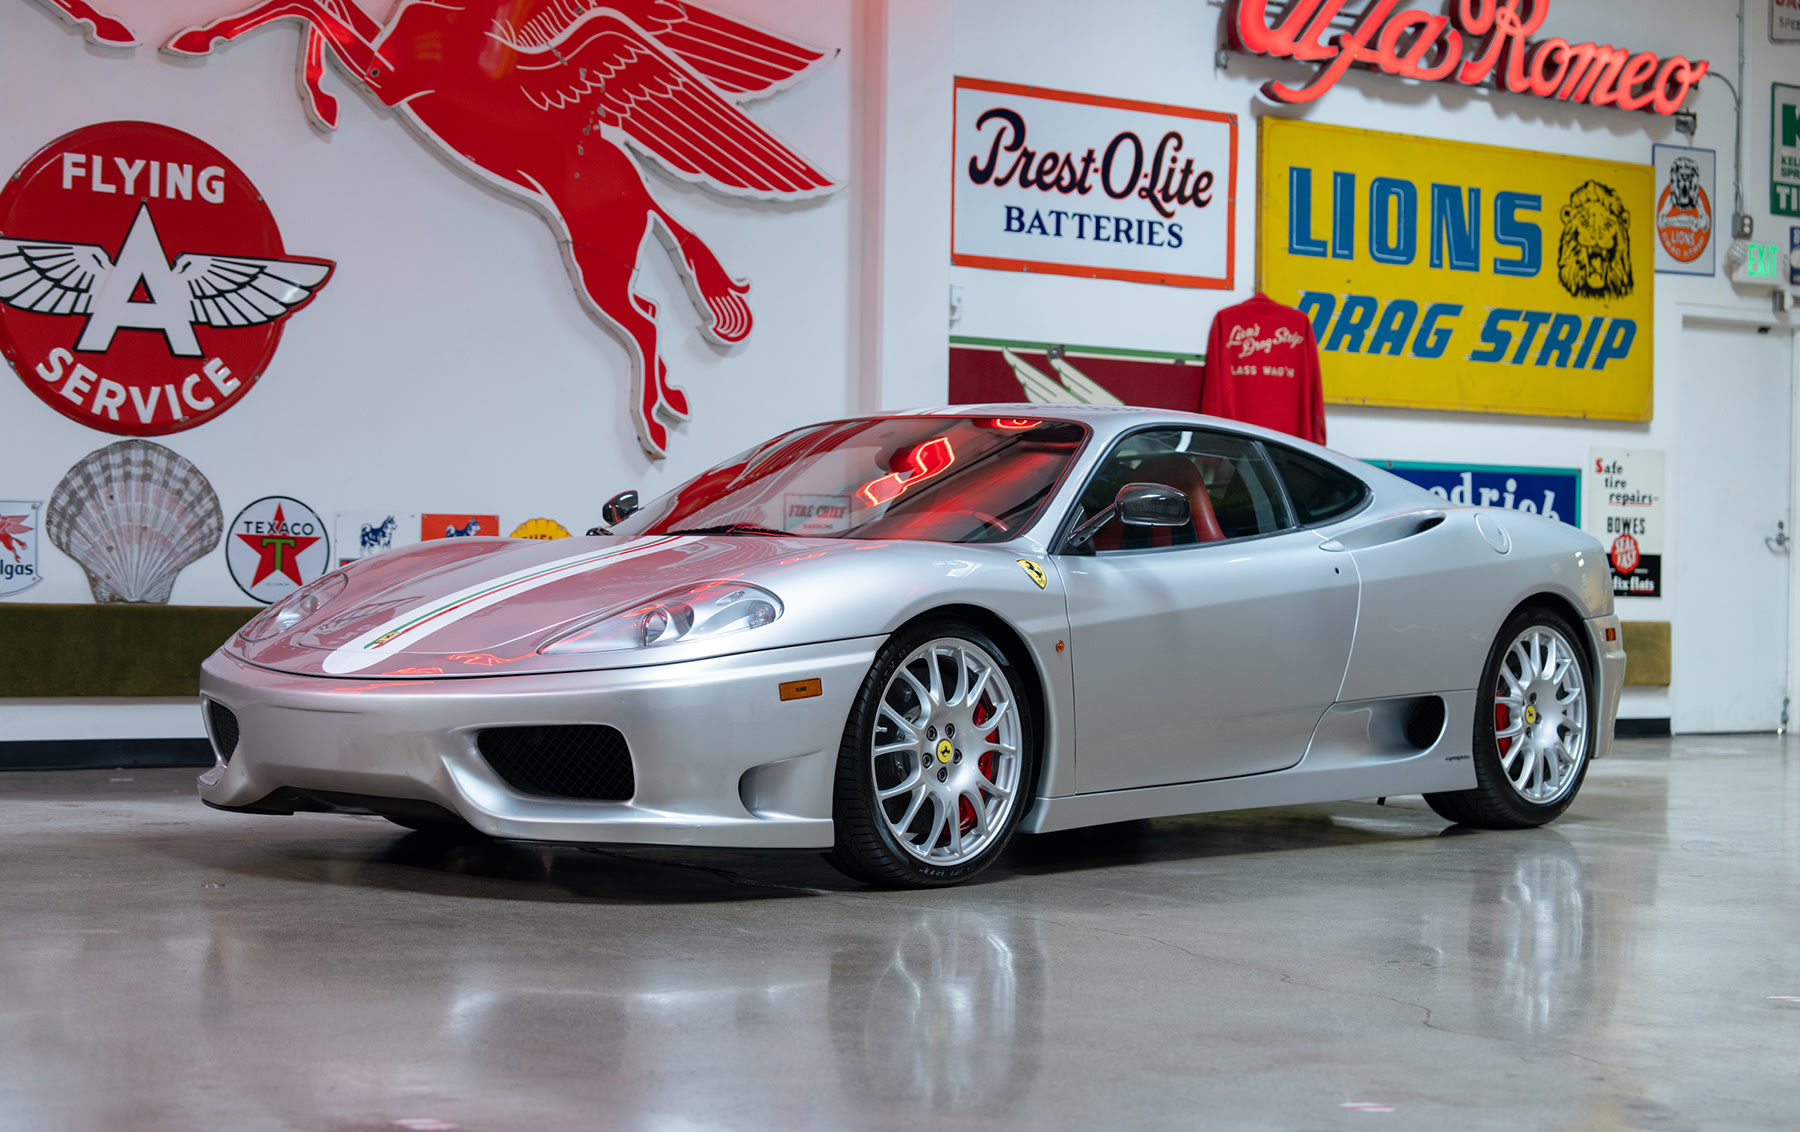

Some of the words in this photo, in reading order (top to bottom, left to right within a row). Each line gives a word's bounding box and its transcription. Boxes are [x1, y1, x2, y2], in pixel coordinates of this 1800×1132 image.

[1456, 0, 1709, 115] Romeo
[1782, 155, 1800, 167] KEL
[62, 152, 226, 204] FLYING
[1776, 184, 1800, 212] TI
[1003, 204, 1184, 249] BATTERIES
[1288, 166, 1543, 278] LIONS
[1748, 243, 1778, 278] EXIT
[73, 199, 206, 359] A
[1296, 289, 1464, 360] DRAG
[1465, 305, 1638, 371] STRIP
[1238, 336, 1273, 359] Drag
[35, 346, 242, 424] SERVICE
[1595, 458, 1623, 475] Safe
[1604, 475, 1627, 488] tire
[789, 503, 814, 518] FIRE
[816, 504, 847, 519] CHIEF
[244, 520, 315, 536] TEXACO
[1607, 516, 1645, 535] BOWES
[261, 537, 297, 572] T
[1615, 536, 1635, 551] SEAL
[1616, 550, 1637, 569] FAST
[1630, 575, 1656, 592] flats
